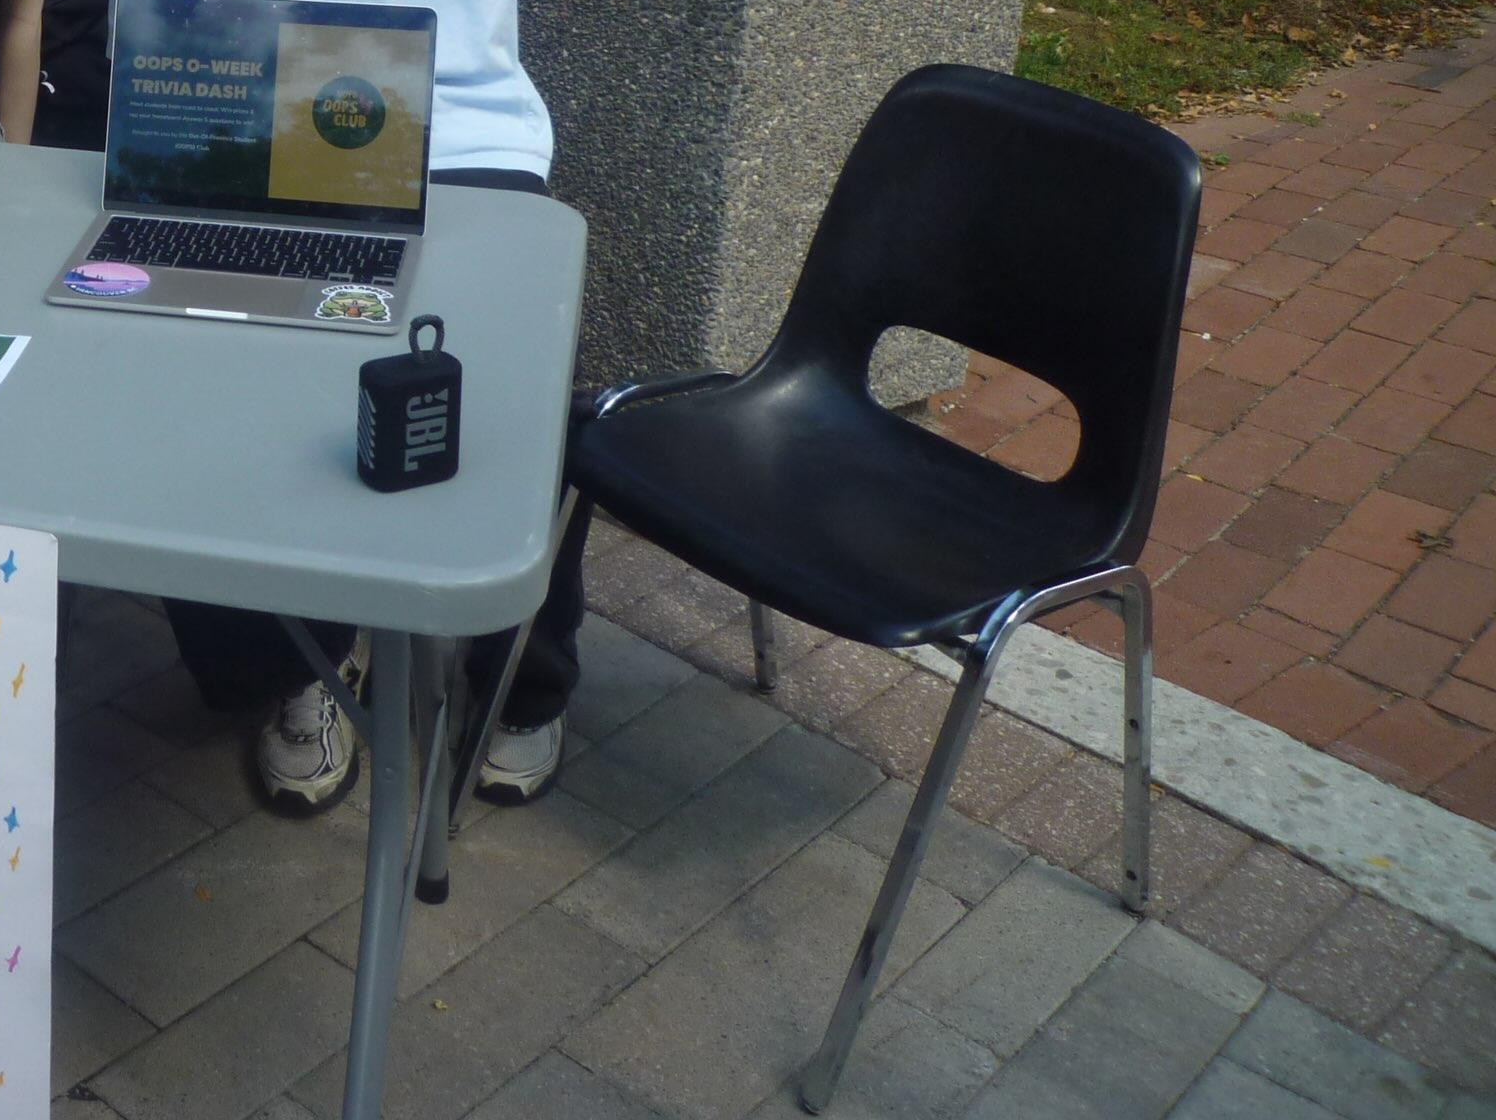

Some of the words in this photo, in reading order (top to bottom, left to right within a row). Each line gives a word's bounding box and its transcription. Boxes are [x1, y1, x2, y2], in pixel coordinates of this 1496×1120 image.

[133, 55, 184, 72] OOPS
[132, 79, 192, 97] TRIVIA
[195, 82, 248, 100] DASH
[324, 99, 359, 114] OOPS
[333, 112, 367, 129] CLUB
[405, 388, 448, 472] JBL
